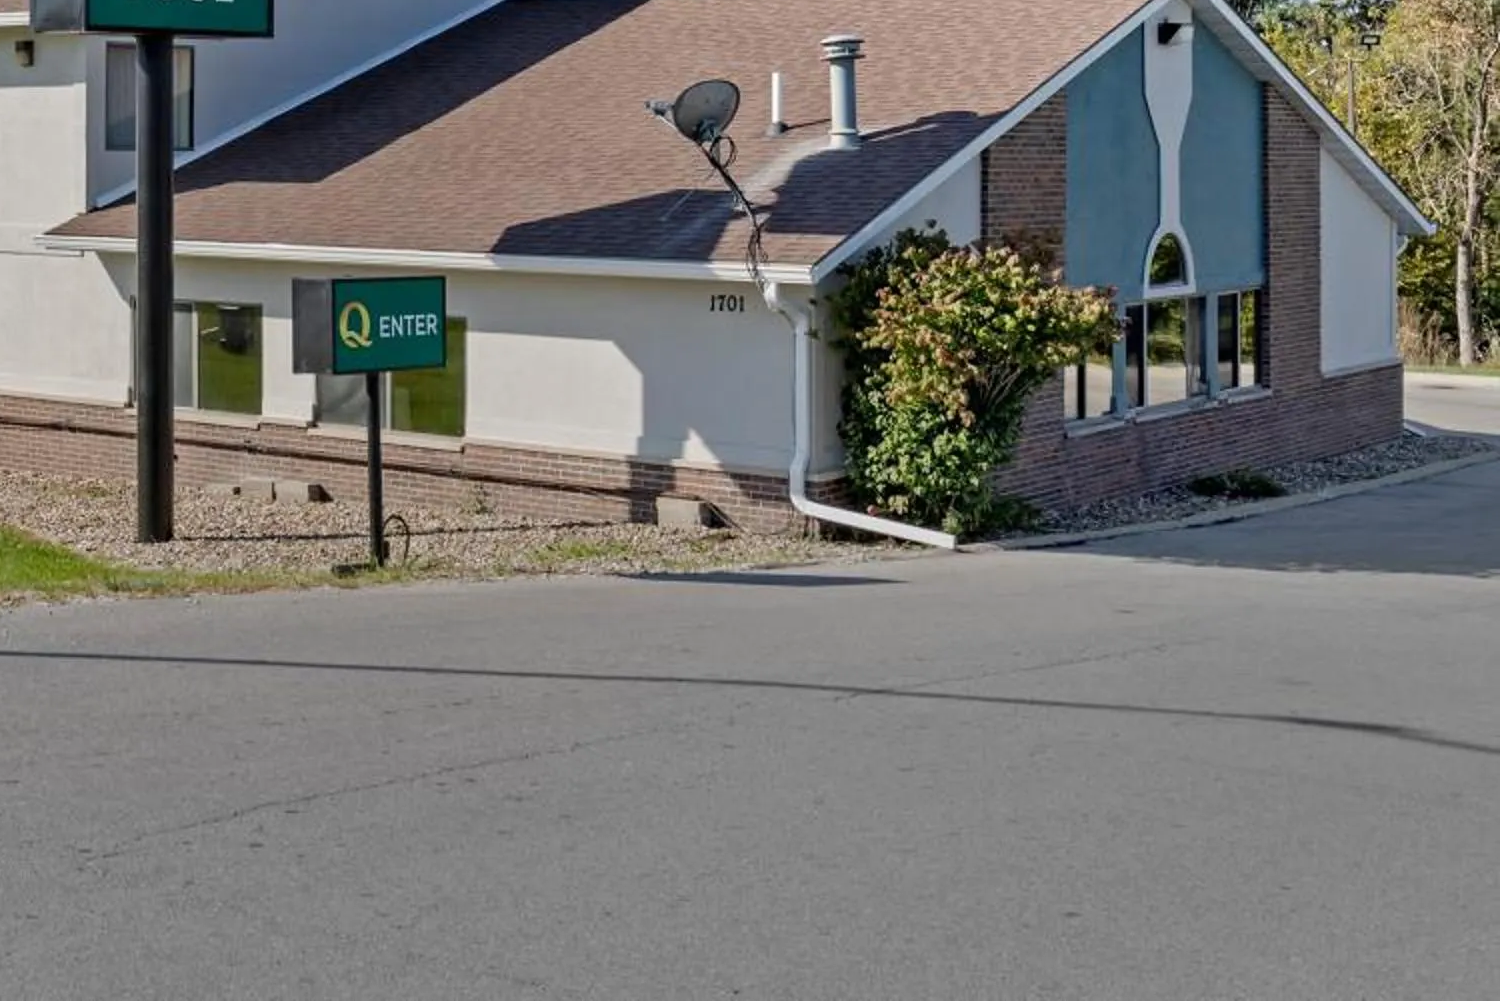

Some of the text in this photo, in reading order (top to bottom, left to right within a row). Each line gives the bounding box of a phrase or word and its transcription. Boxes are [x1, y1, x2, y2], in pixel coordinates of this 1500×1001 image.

[709, 294, 745, 312] 1701
[339, 301, 438, 348] Q ENTER
